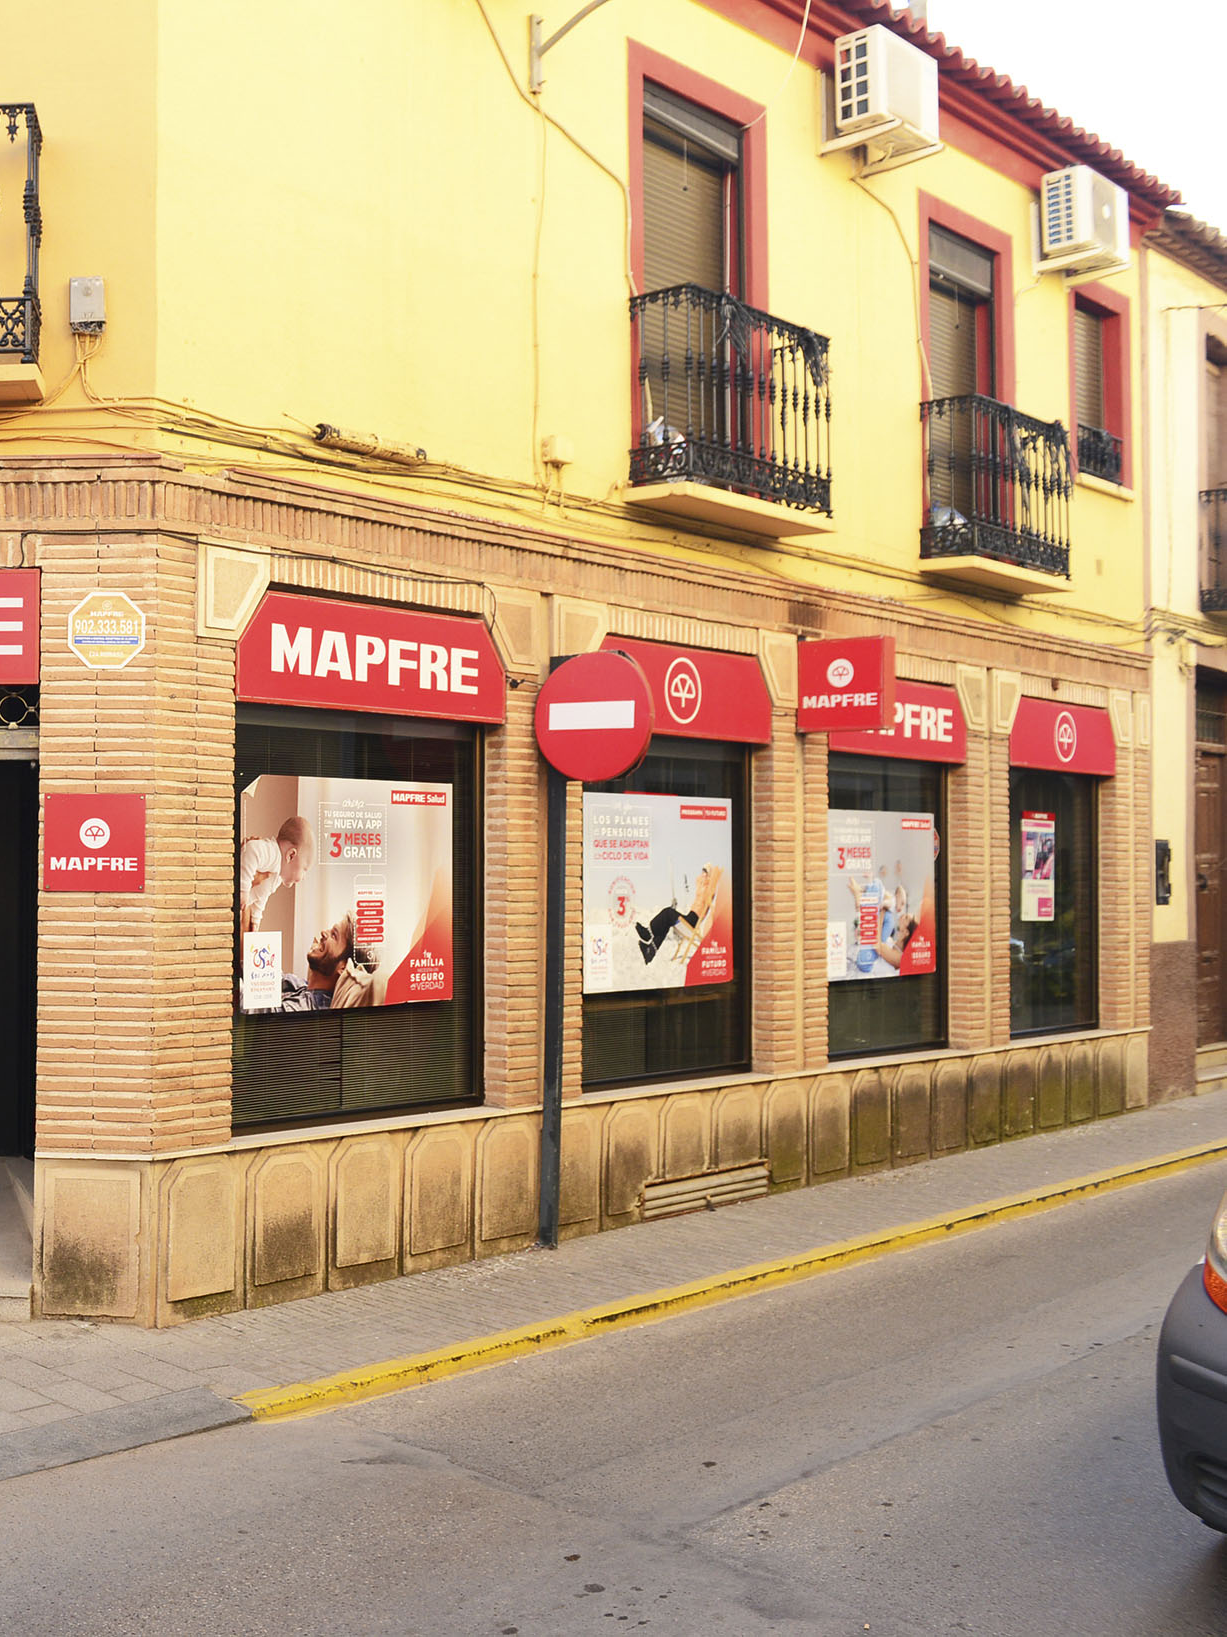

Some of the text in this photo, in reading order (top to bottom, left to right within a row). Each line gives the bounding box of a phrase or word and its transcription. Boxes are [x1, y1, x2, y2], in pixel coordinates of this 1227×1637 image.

[75, 619, 138, 634] 902.333.581
[271, 623, 479, 694] MAPFRE
[802, 692, 878, 709] MAPFRE
[392, 793, 445, 804] MAPFRE Salud
[334, 819, 364, 829] NUEVA
[365, 819, 382, 829] APP
[593, 816, 649, 825] LOS PLANES
[601, 828, 649, 837] PENSIONES
[344, 833, 381, 845] MESES
[593, 840, 650, 848] QUE SE ADAPTAN
[330, 833, 342, 857] 3
[343, 846, 382, 858] GRATIS
[634, 852, 649, 860] VIDA
[50, 856, 139, 871] MAPFRE
[837, 847, 845, 869] 3
[409, 958, 444, 967] FAMILIA
[409, 972, 445, 982] SEGURO
